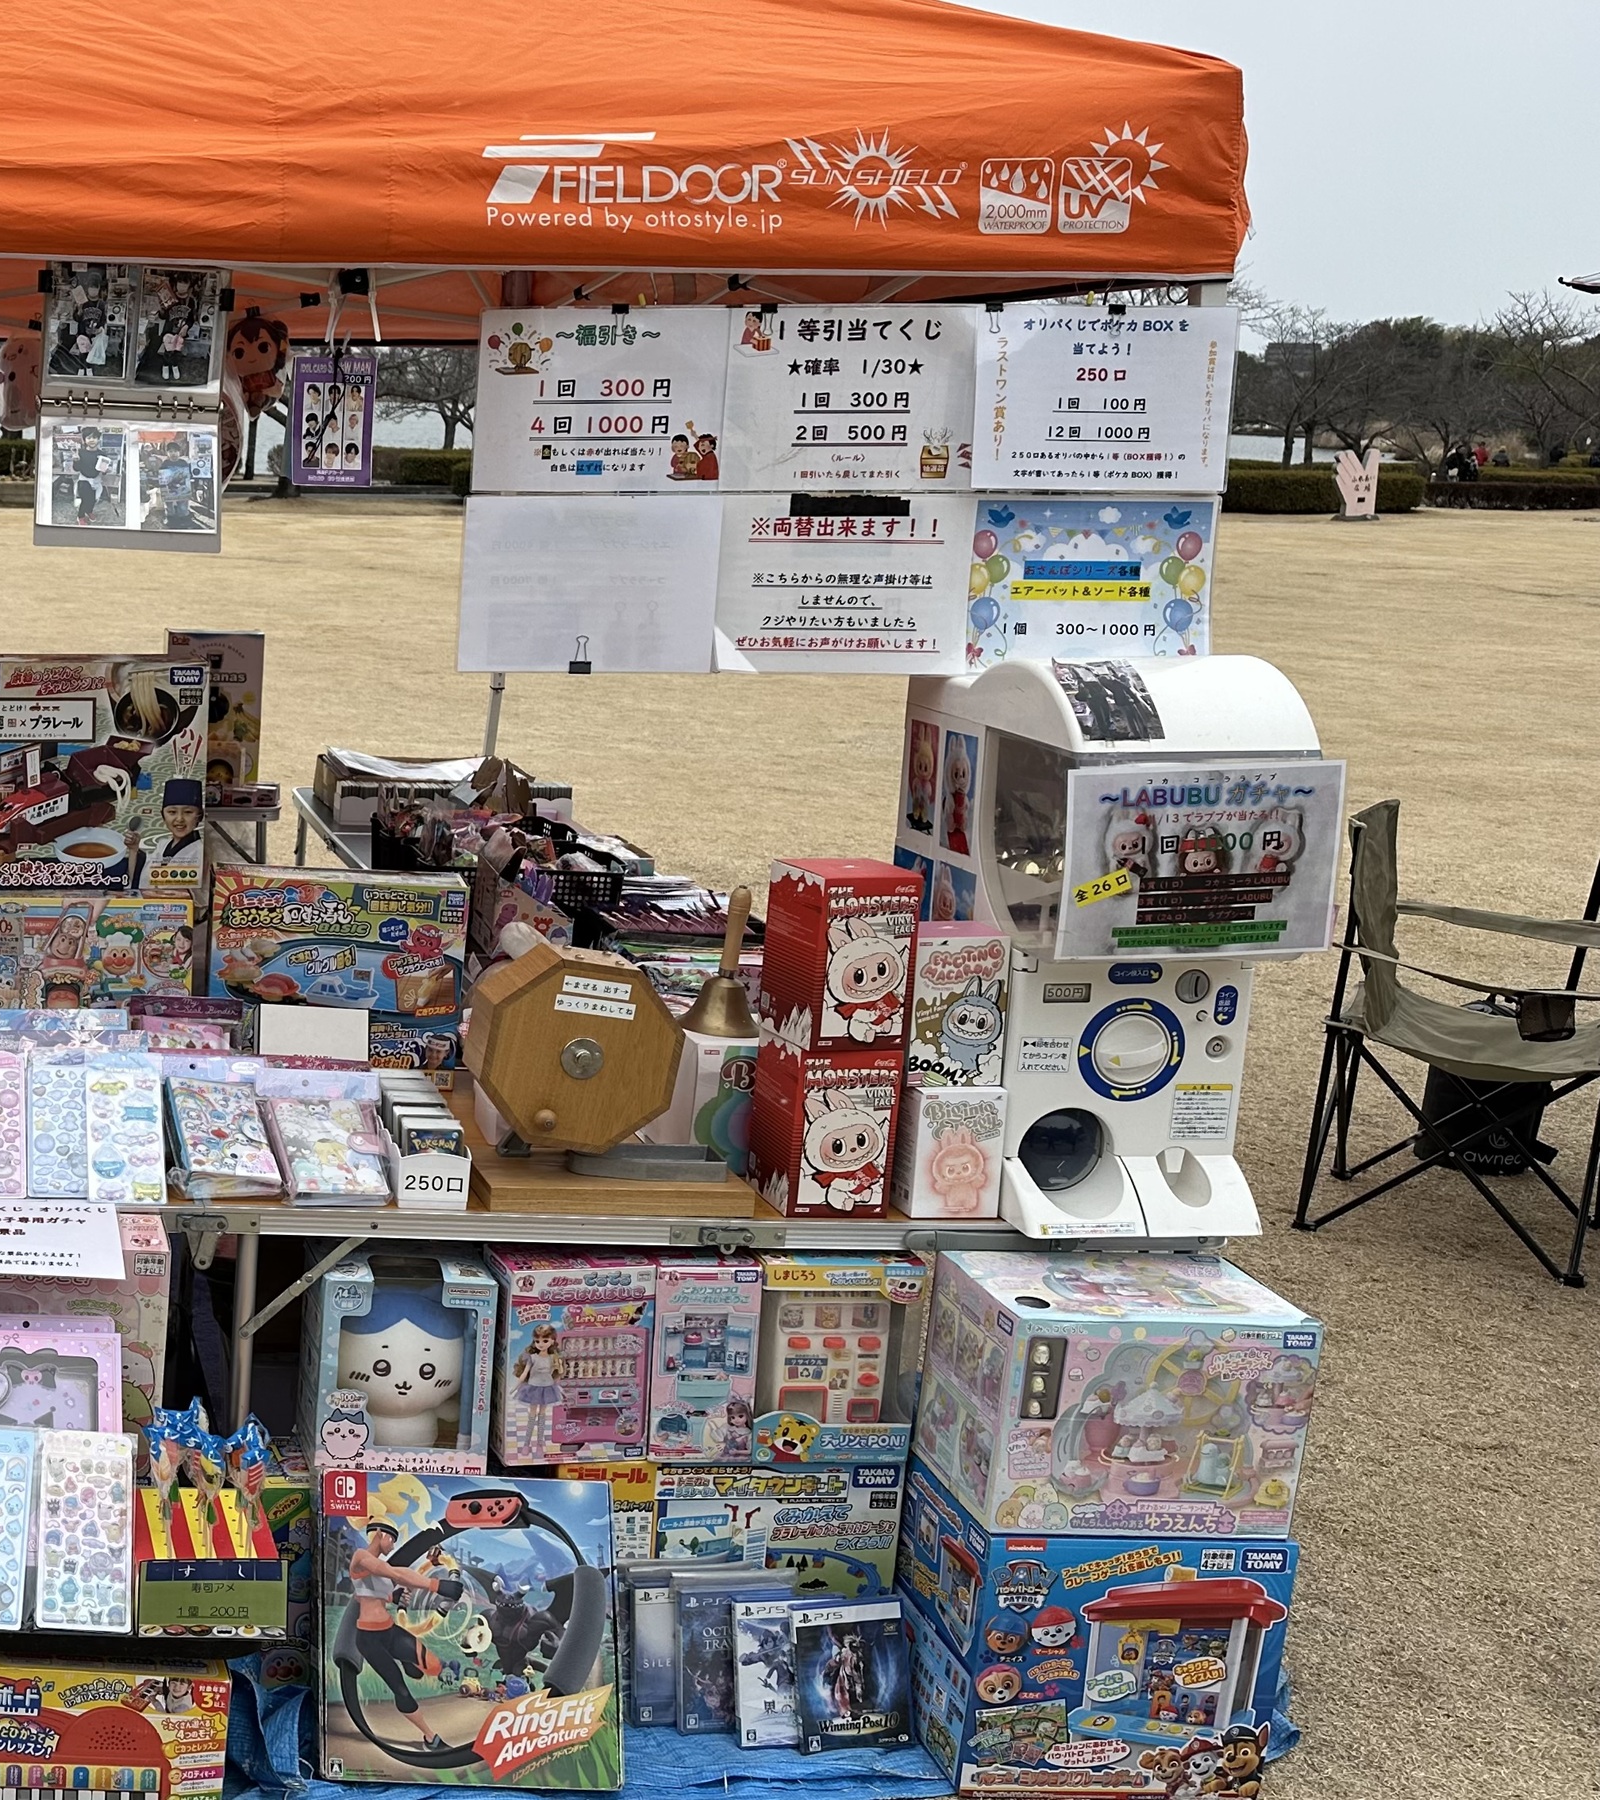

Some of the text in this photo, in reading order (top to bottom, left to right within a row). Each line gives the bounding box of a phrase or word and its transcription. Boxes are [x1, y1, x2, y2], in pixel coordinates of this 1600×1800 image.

[550, 161, 781, 204] FIELDOOR
[985, 205, 1048, 219] 2,000mm
[486, 206, 782, 234] Powered by ottostyle.jp
[983, 220, 1047, 230] WATERPROOF
[1062, 220, 1125, 229] PROTECTION
[353, 362, 371, 373] MAN
[600, 379, 671, 398] 300円
[850, 392, 909, 408] 300円
[1103, 398, 1146, 411] 100円
[587, 415, 669, 435] 1000円
[848, 425, 907, 441] 500円
[1098, 426, 1150, 440] 1000円
[171, 669, 201, 677] TAKARA
[173, 675, 200, 684] TOMY
[29, 716, 84, 731] プラレール
[828, 896, 920, 921] MONSTERS
[886, 916, 916, 926] VINYL
[317, 923, 370, 935] BASIC
[894, 924, 916, 935] FACE
[1047, 987, 1084, 999] 500円
[804, 1068, 899, 1089] MONSTERS
[865, 1089, 896, 1100] VINYL
[874, 1097, 896, 1107] FACE
[774, 1270, 816, 1281] しまじろう
[1285, 1340, 1313, 1349] TOMY
[857, 1468, 896, 1477] TAKARA
[857, 1476, 896, 1485] TOMY
[1245, 1553, 1282, 1561] TAKARA
[1245, 1561, 1282, 1569] TOMY
[191, 1582, 235, 1593] 寿司アメ
[1003, 1596, 1039, 1604] PATROL
[210, 1606, 249, 1617] 200円
[756, 1605, 786, 1615] PS5
[813, 1610, 843, 1620] PS5
[818, 1720, 861, 1733] Winning
[494, 1725, 591, 1768] Adventure
